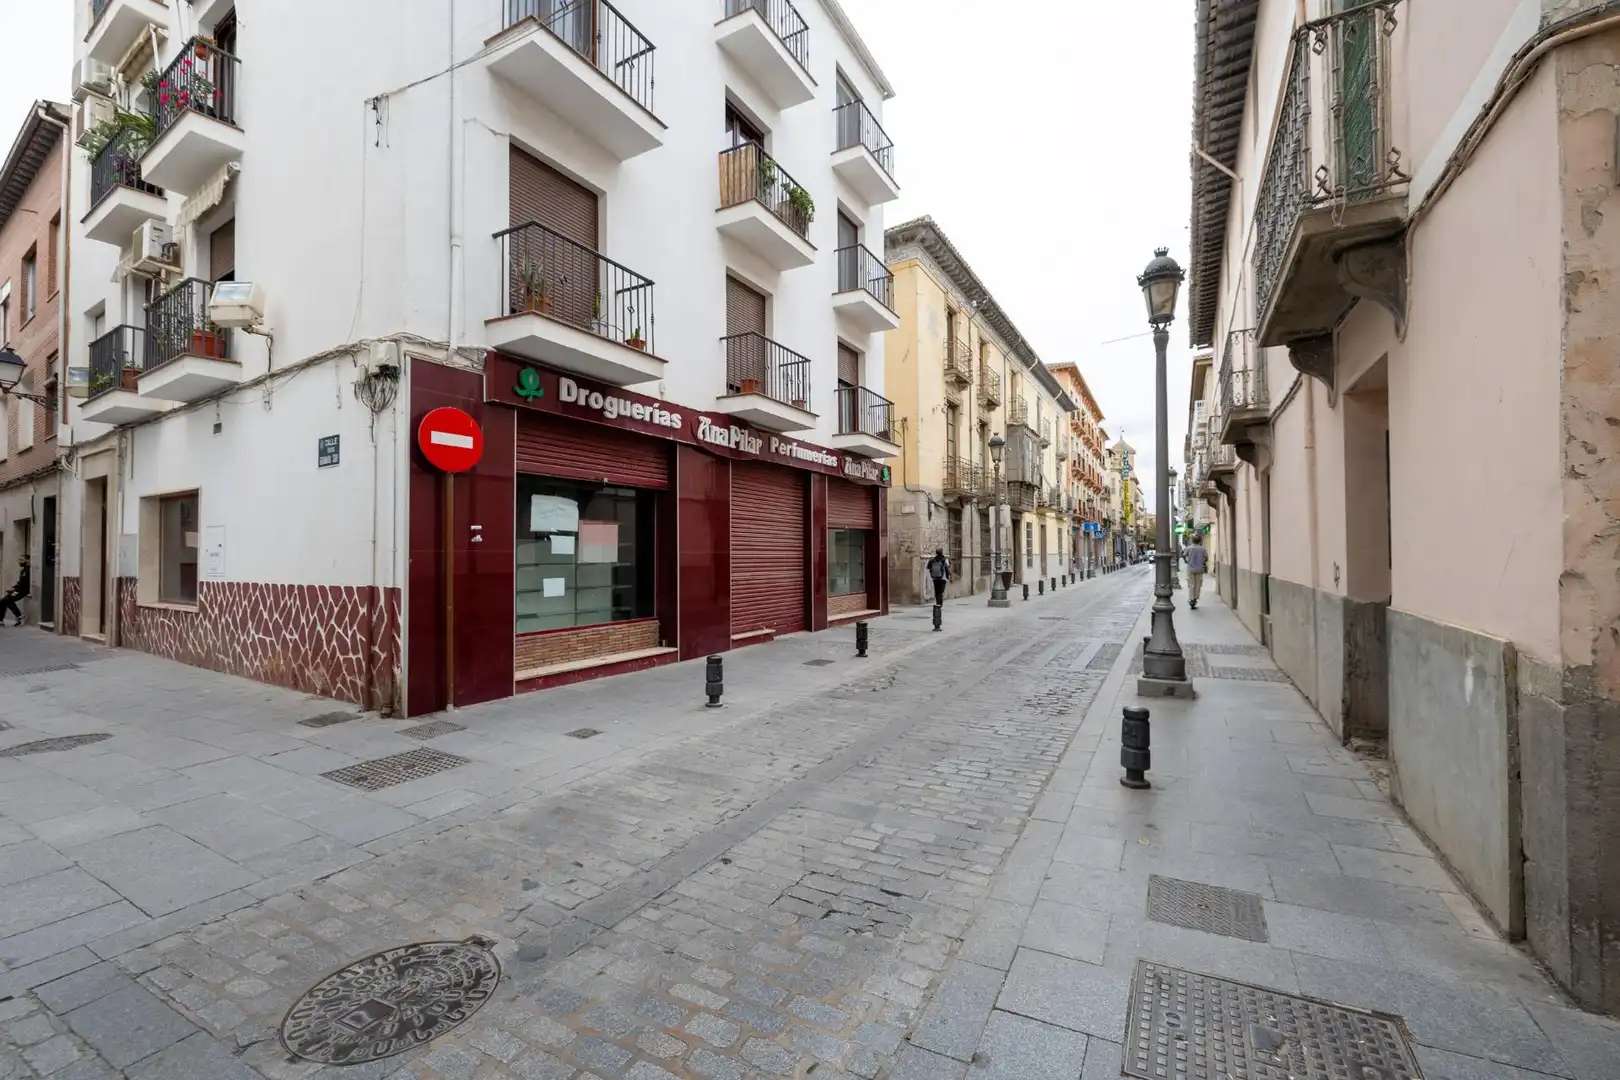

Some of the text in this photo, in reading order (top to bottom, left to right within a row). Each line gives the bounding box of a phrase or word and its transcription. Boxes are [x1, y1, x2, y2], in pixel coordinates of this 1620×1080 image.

[324, 437, 338, 447] CALLE
[559, 377, 682, 429] Droguerías
[770, 436, 838, 468] Perfumerías
